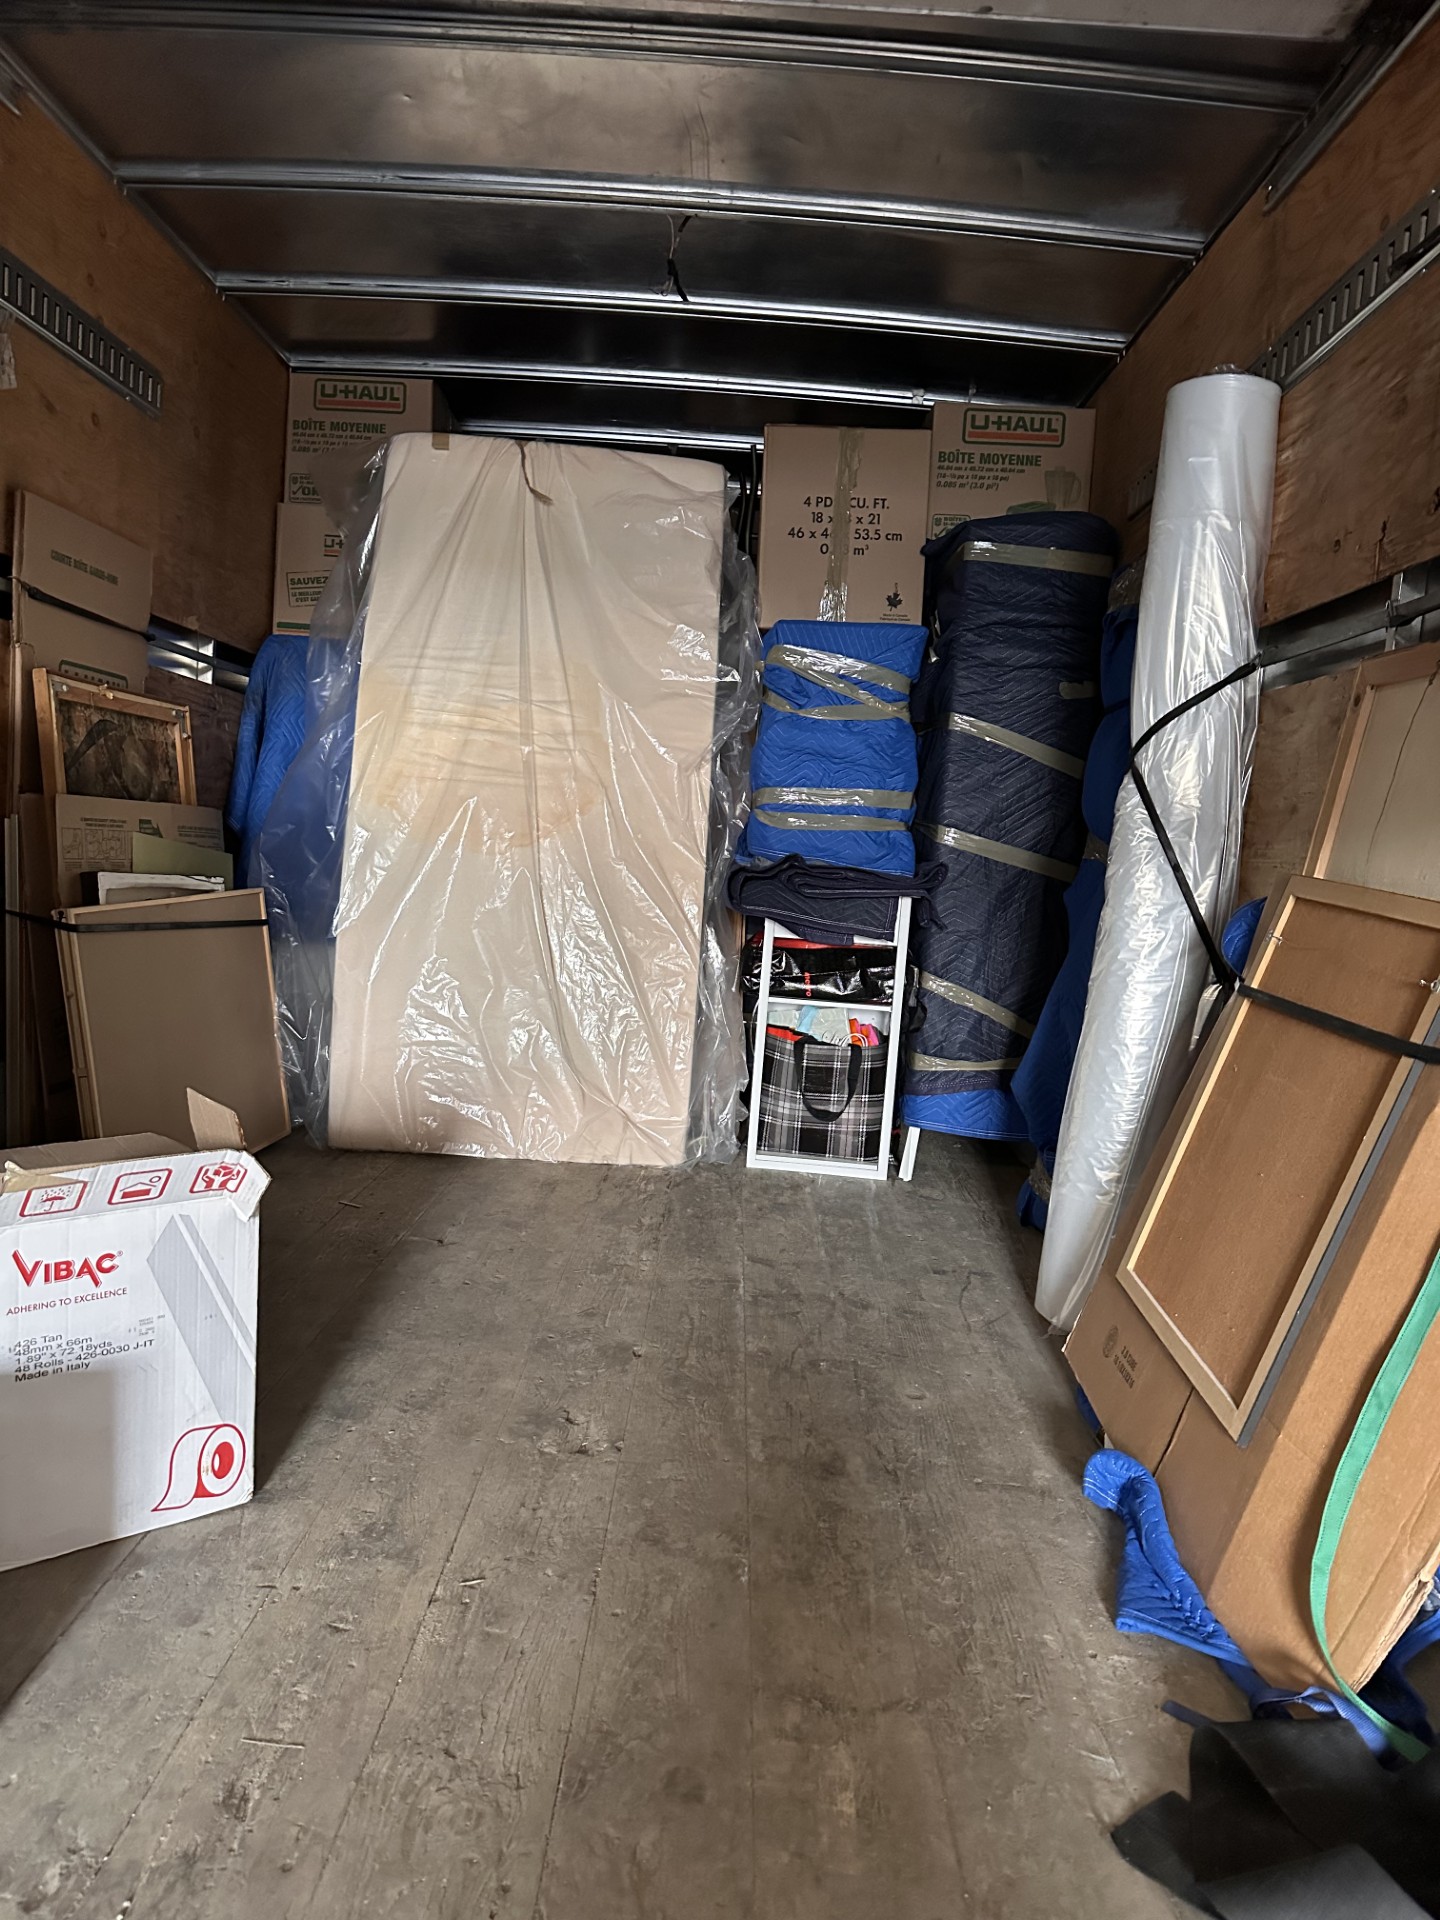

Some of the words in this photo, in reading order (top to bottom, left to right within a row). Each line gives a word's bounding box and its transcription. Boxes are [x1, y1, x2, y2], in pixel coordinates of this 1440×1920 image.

[320, 383, 400, 401] U-HAUL
[292, 418, 326, 431] BOÎTE
[330, 421, 387, 434] MOYENNE
[970, 414, 1059, 433] U-HAUL
[938, 449, 975, 464] BOÎTE
[979, 452, 1042, 467] MOYENNE
[804, 496, 812, 508] 4
[873, 498, 890, 509] FT.
[811, 511, 824, 523] 18
[856, 516, 864, 525] x
[868, 513, 881, 525] 21
[787, 527, 805, 539] 46
[808, 530, 817, 539] x
[853, 529, 881, 541] 53.5
[885, 531, 903, 541] cm
[6, 1300, 57, 1316] ADHERING
[59, 1297, 72, 1307] TO
[74, 1287, 128, 1304] EXCELLENCE
[14, 1337, 37, 1348] 426
[41, 1334, 63, 1343] Tan
[14, 1344, 53, 1356] 48mm
[66, 1336, 93, 1347] 66m
[14, 1364, 30, 1373] 48
[34, 1358, 64, 1370] Rolls
[75, 1344, 130, 1361] 426-0030
[133, 1338, 155, 1350] J-IT
[14, 1369, 49, 1382] Made
[52, 1366, 63, 1375] in
[67, 1360, 91, 1371] Italy
